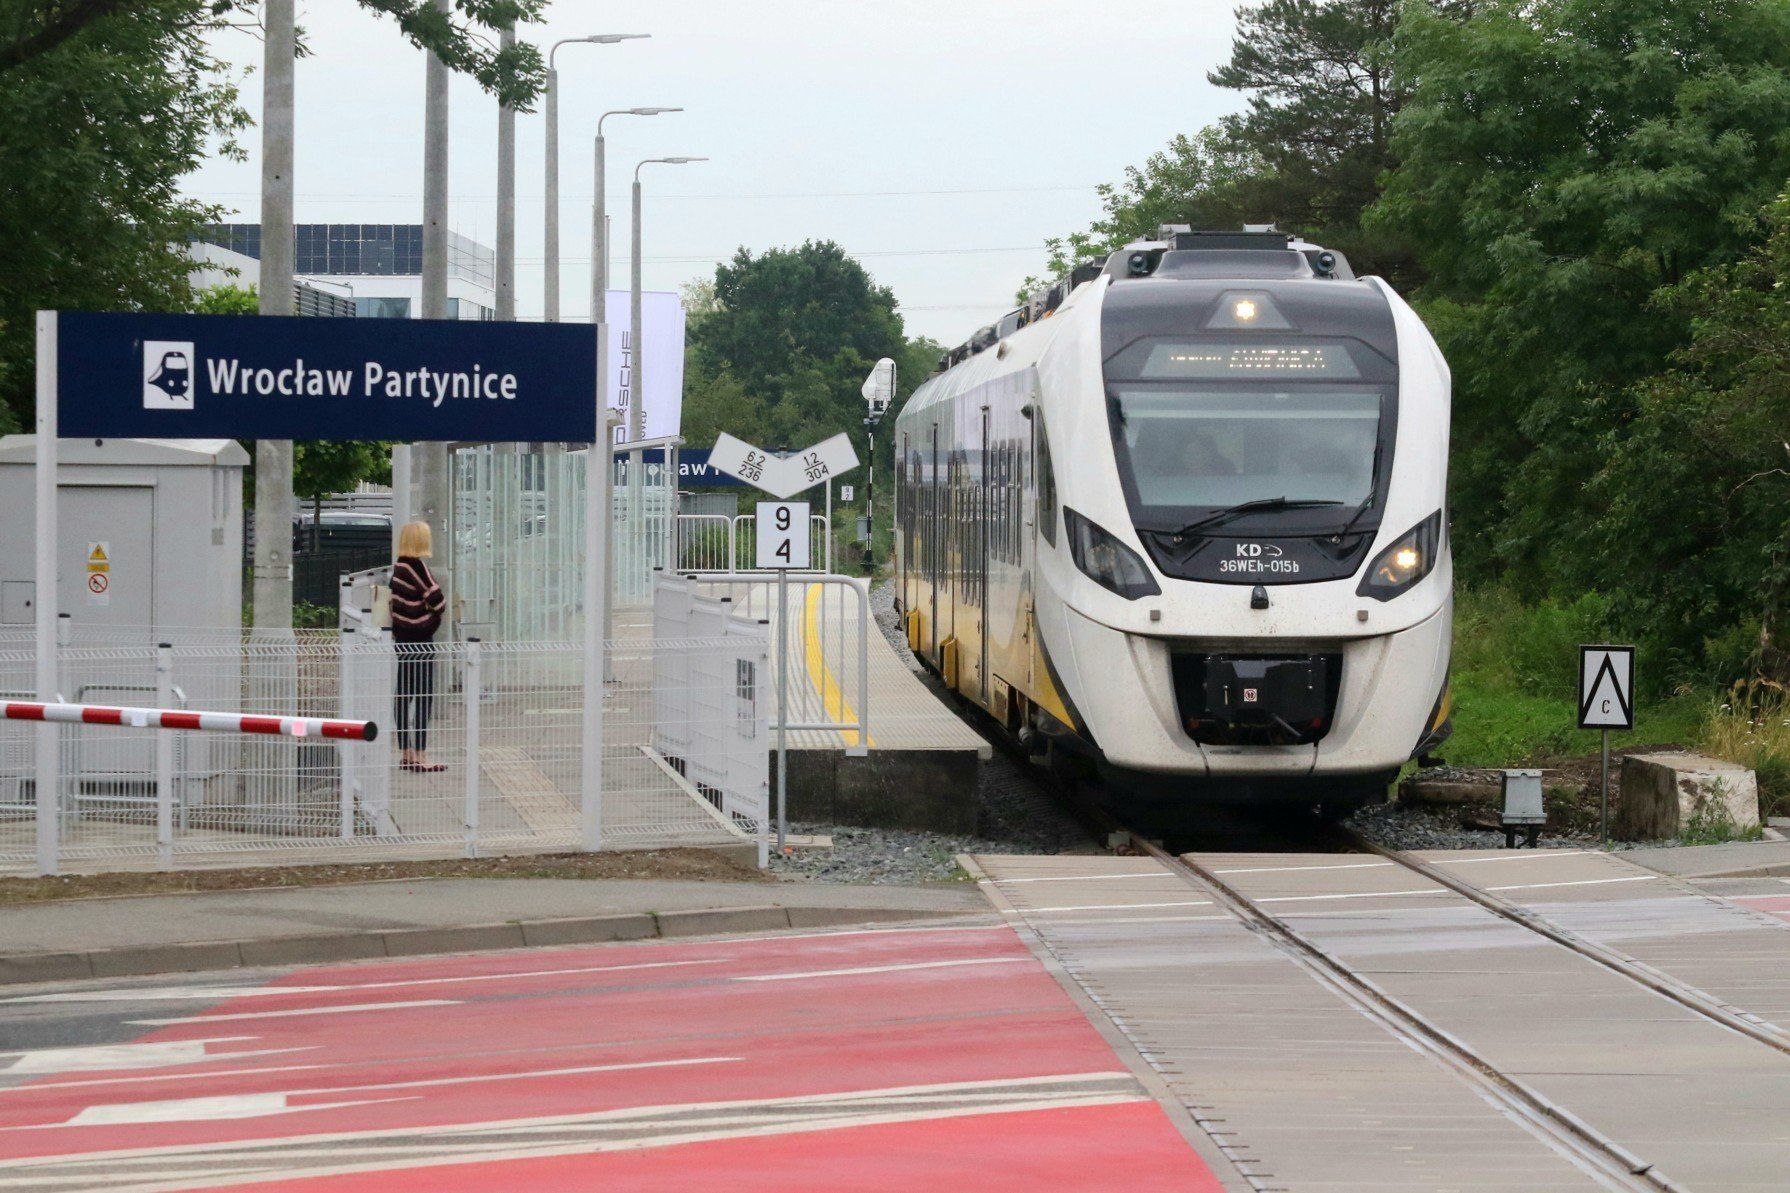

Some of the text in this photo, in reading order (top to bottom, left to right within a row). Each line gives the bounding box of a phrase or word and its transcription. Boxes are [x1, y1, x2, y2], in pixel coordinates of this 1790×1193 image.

[207, 358, 518, 407] Wrocław Partynice
[615, 331, 631, 444] OSCHE
[746, 451, 766, 466] 6.2
[803, 452, 819, 467] 1.2
[738, 464, 762, 482] 236
[806, 464, 830, 482] 304
[775, 506, 791, 531] 9
[775, 538, 791, 564] 4
[1236, 543, 1262, 557] KD
[1220, 559, 1300, 573] 36WEh-015b
[1602, 699, 1610, 714] C
